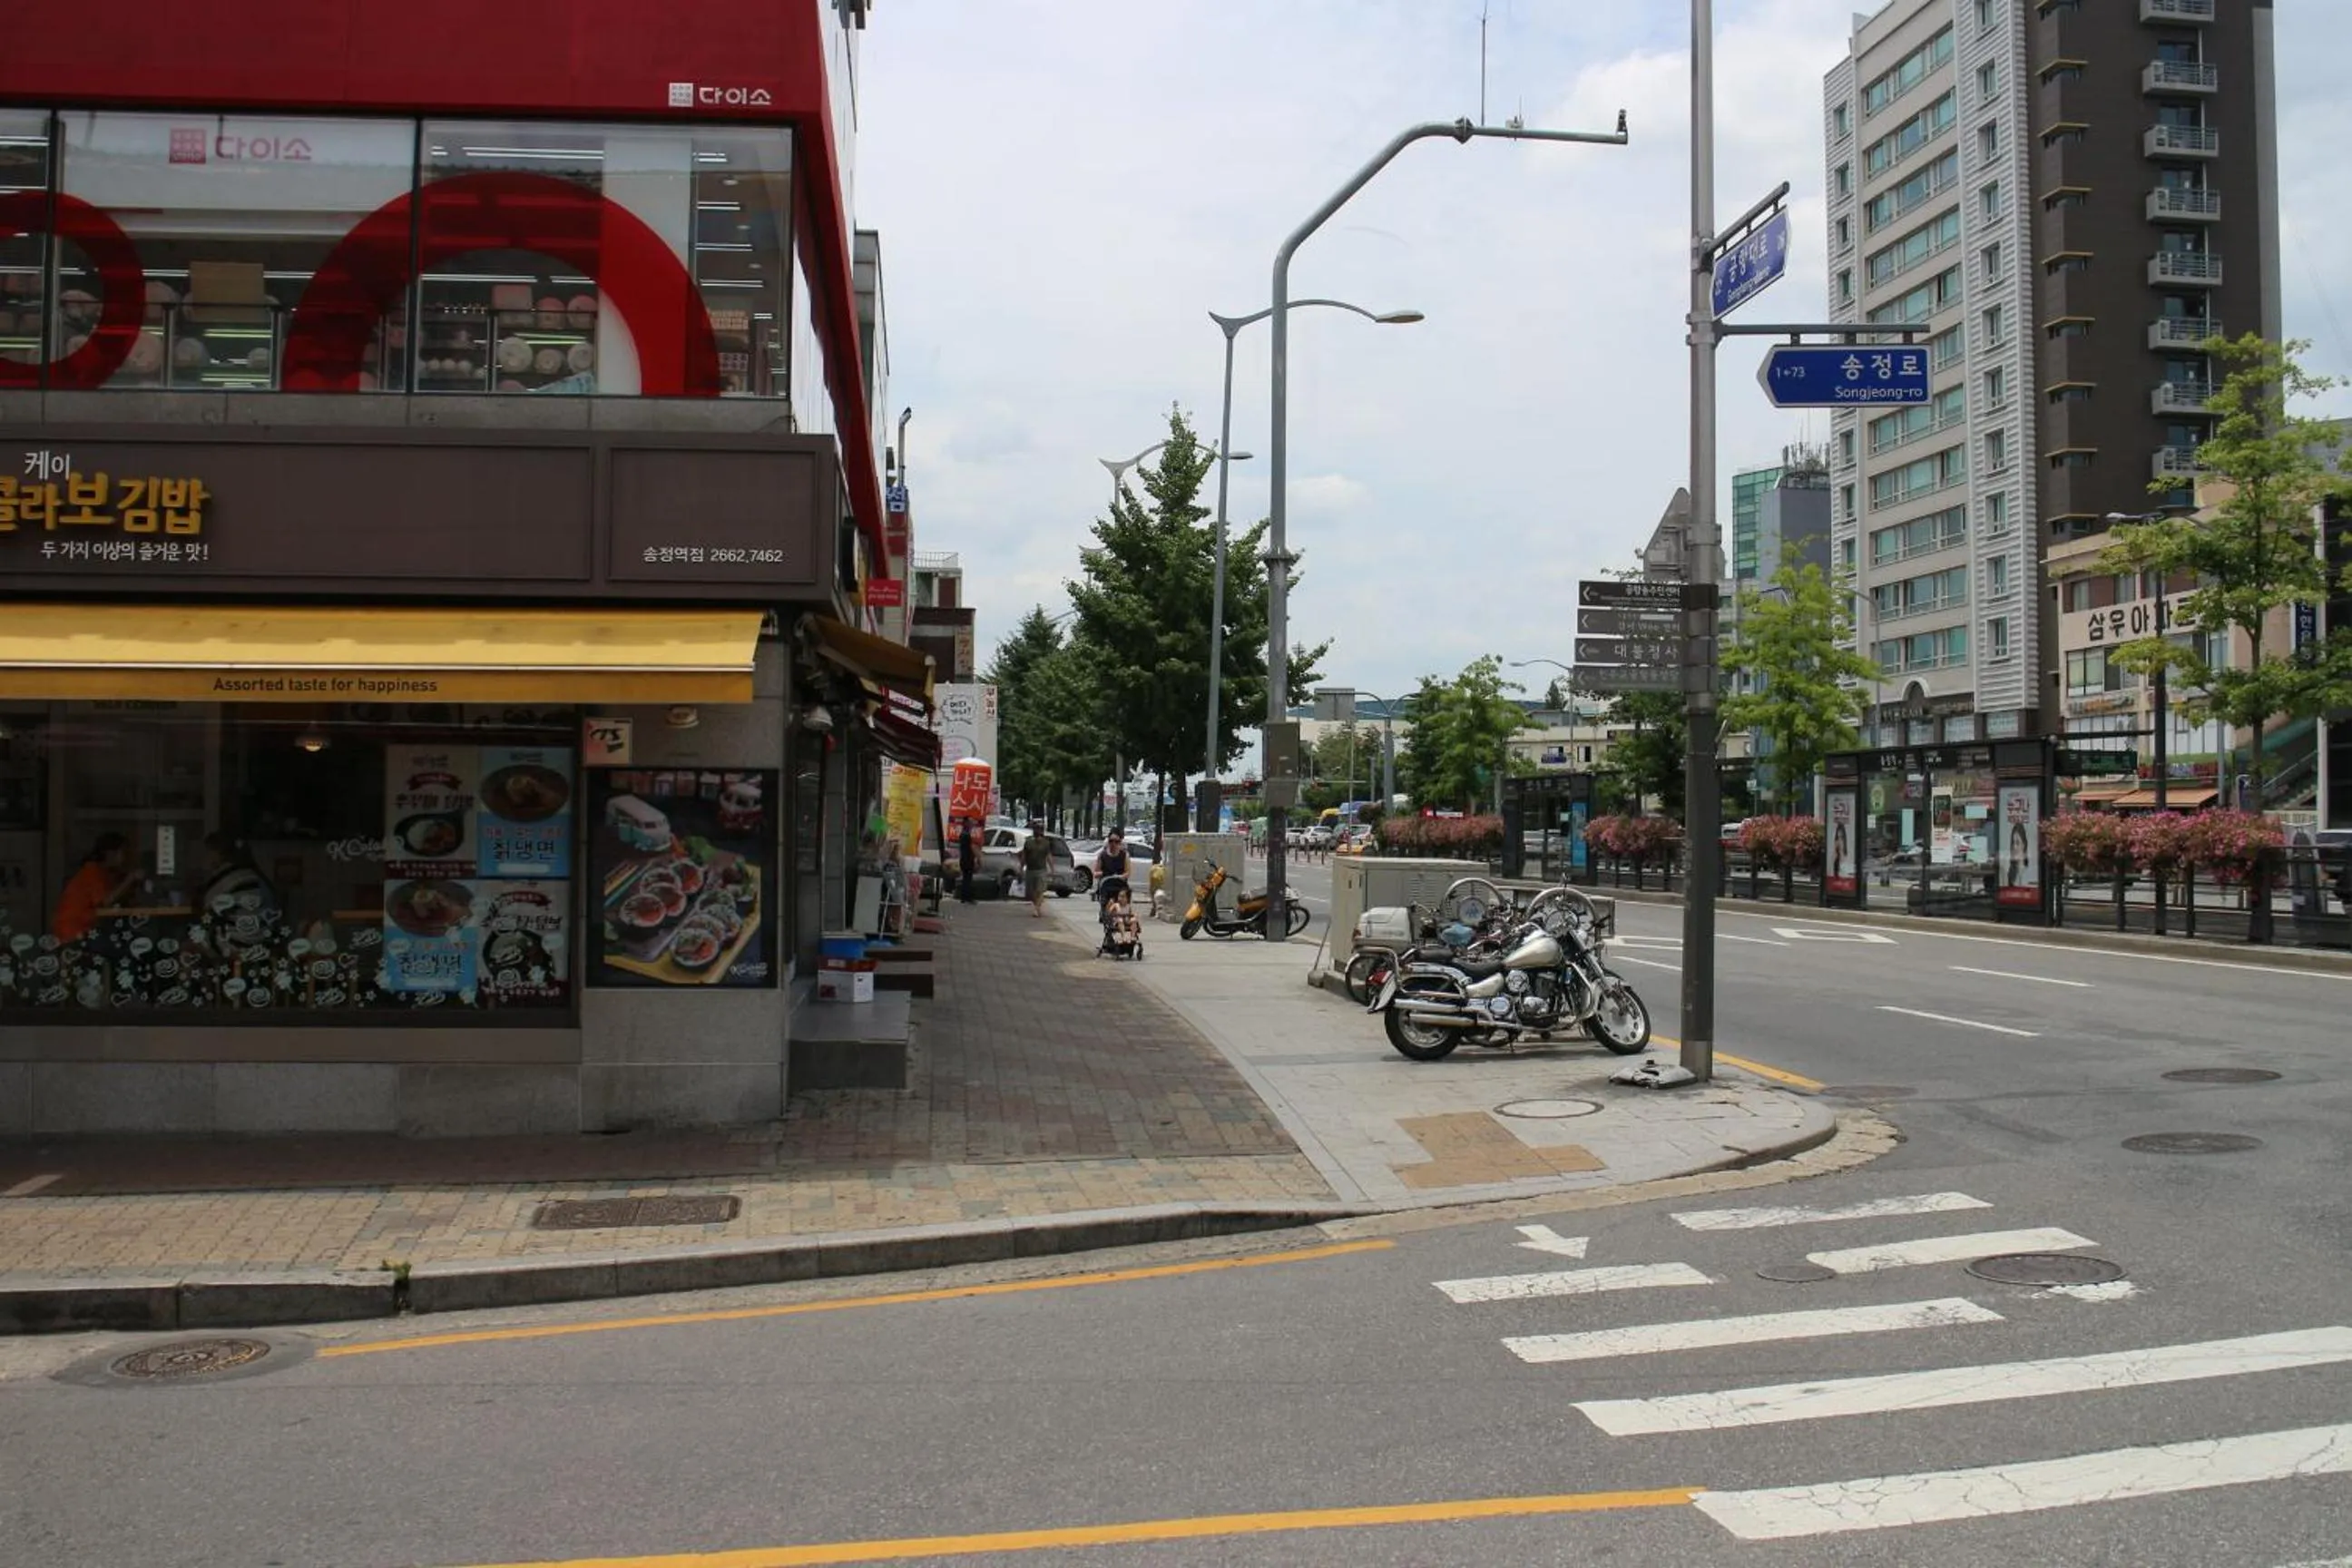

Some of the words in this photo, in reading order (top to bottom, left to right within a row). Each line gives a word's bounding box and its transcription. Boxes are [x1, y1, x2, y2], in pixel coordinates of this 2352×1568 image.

[699, 87, 771, 105] 다이소
[215, 136, 311, 161] 다이소
[1840, 353, 1922, 380] 송정로
[1835, 387, 1924, 400] Songjeong-ro
[24, 450, 71, 481] 케이
[41, 542, 57, 559] 두
[60, 540, 89, 560] 가지
[93, 541, 135, 561] 이상의
[139, 542, 182, 561] 즐거운
[185, 542, 209, 561] 맛!
[642, 546, 704, 563] 송정역점
[213, 677, 284, 691] Assorted
[289, 679, 327, 691] taste
[331, 677, 354, 691] for
[358, 678, 438, 695] happiness
[955, 769, 988, 790] 나도
[951, 791, 986, 816] 스시
